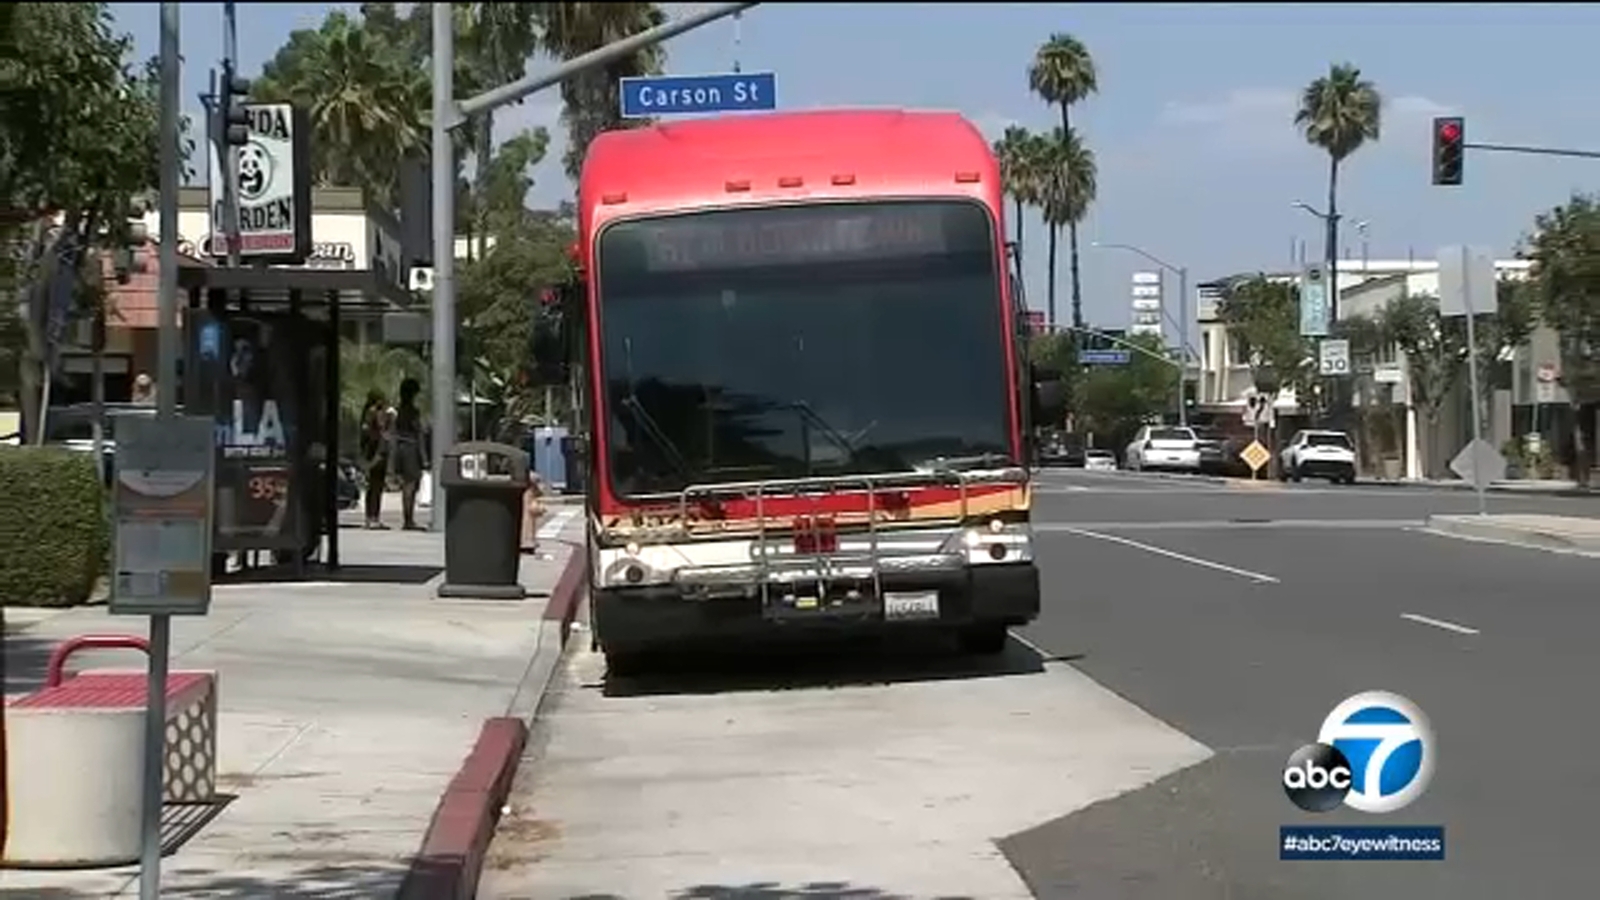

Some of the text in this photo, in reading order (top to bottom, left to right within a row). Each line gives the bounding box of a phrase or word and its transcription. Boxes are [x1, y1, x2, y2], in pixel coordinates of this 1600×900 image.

[639, 81, 759, 107] Carson St
[1323, 358, 1346, 370] 30
